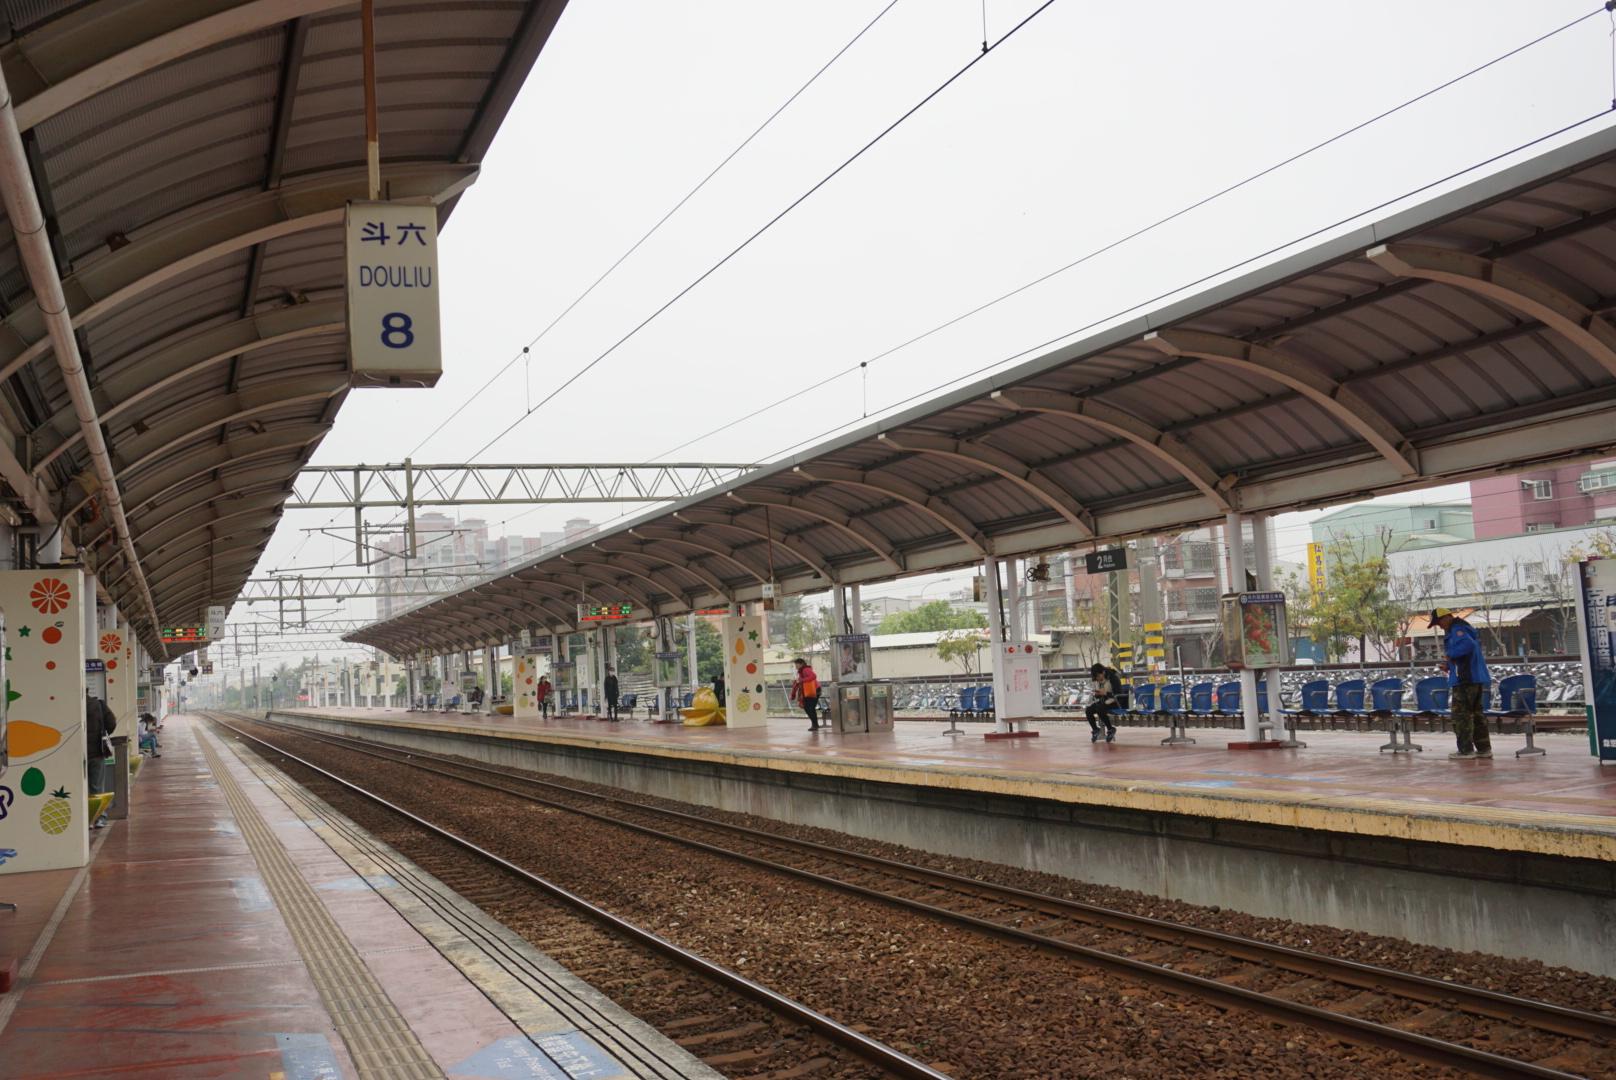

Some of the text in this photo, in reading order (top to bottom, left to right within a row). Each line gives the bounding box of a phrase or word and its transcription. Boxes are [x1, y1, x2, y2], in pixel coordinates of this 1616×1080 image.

[361, 222, 426, 245] 斗六
[360, 266, 431, 287] DOULIU
[381, 312, 414, 348] 8
[1096, 555, 1103, 569] 2
[213, 627, 219, 635] 7
